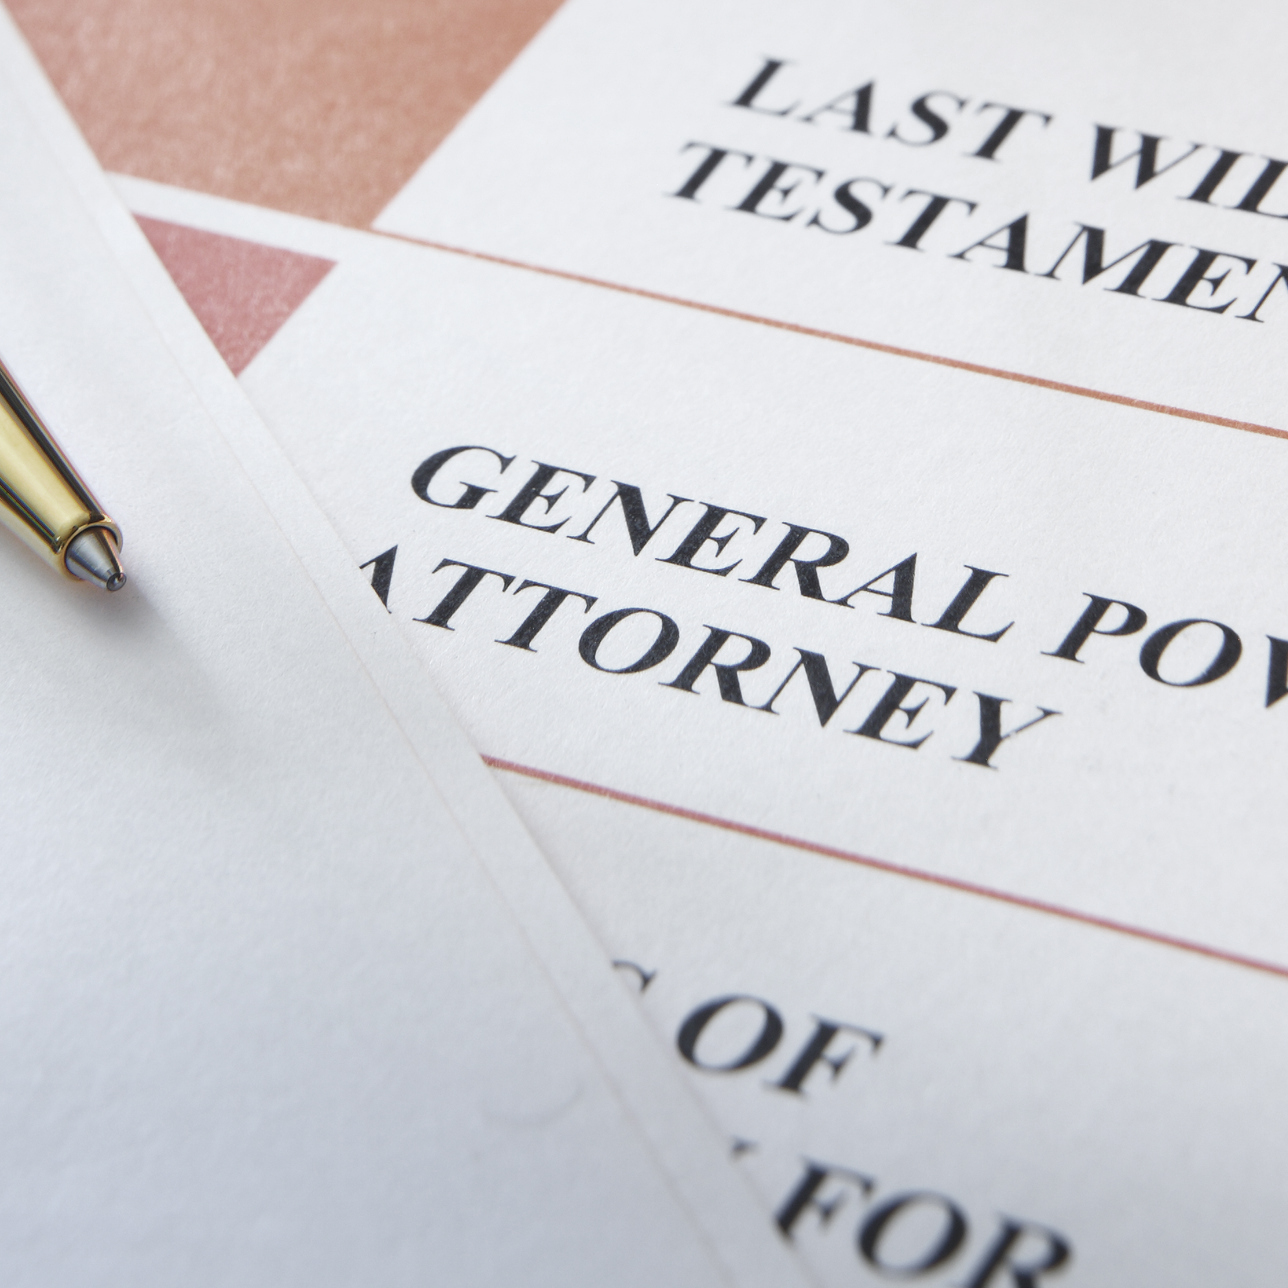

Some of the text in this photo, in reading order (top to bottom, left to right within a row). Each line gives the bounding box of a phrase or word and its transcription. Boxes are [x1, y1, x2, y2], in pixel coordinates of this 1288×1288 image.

[721, 55, 1055, 164] LAST
[410, 444, 1015, 643] GENERAL
[358, 543, 1063, 771] ATTORNEY
[674, 993, 886, 1102] OF
[771, 1158, 1074, 1288] FOR
